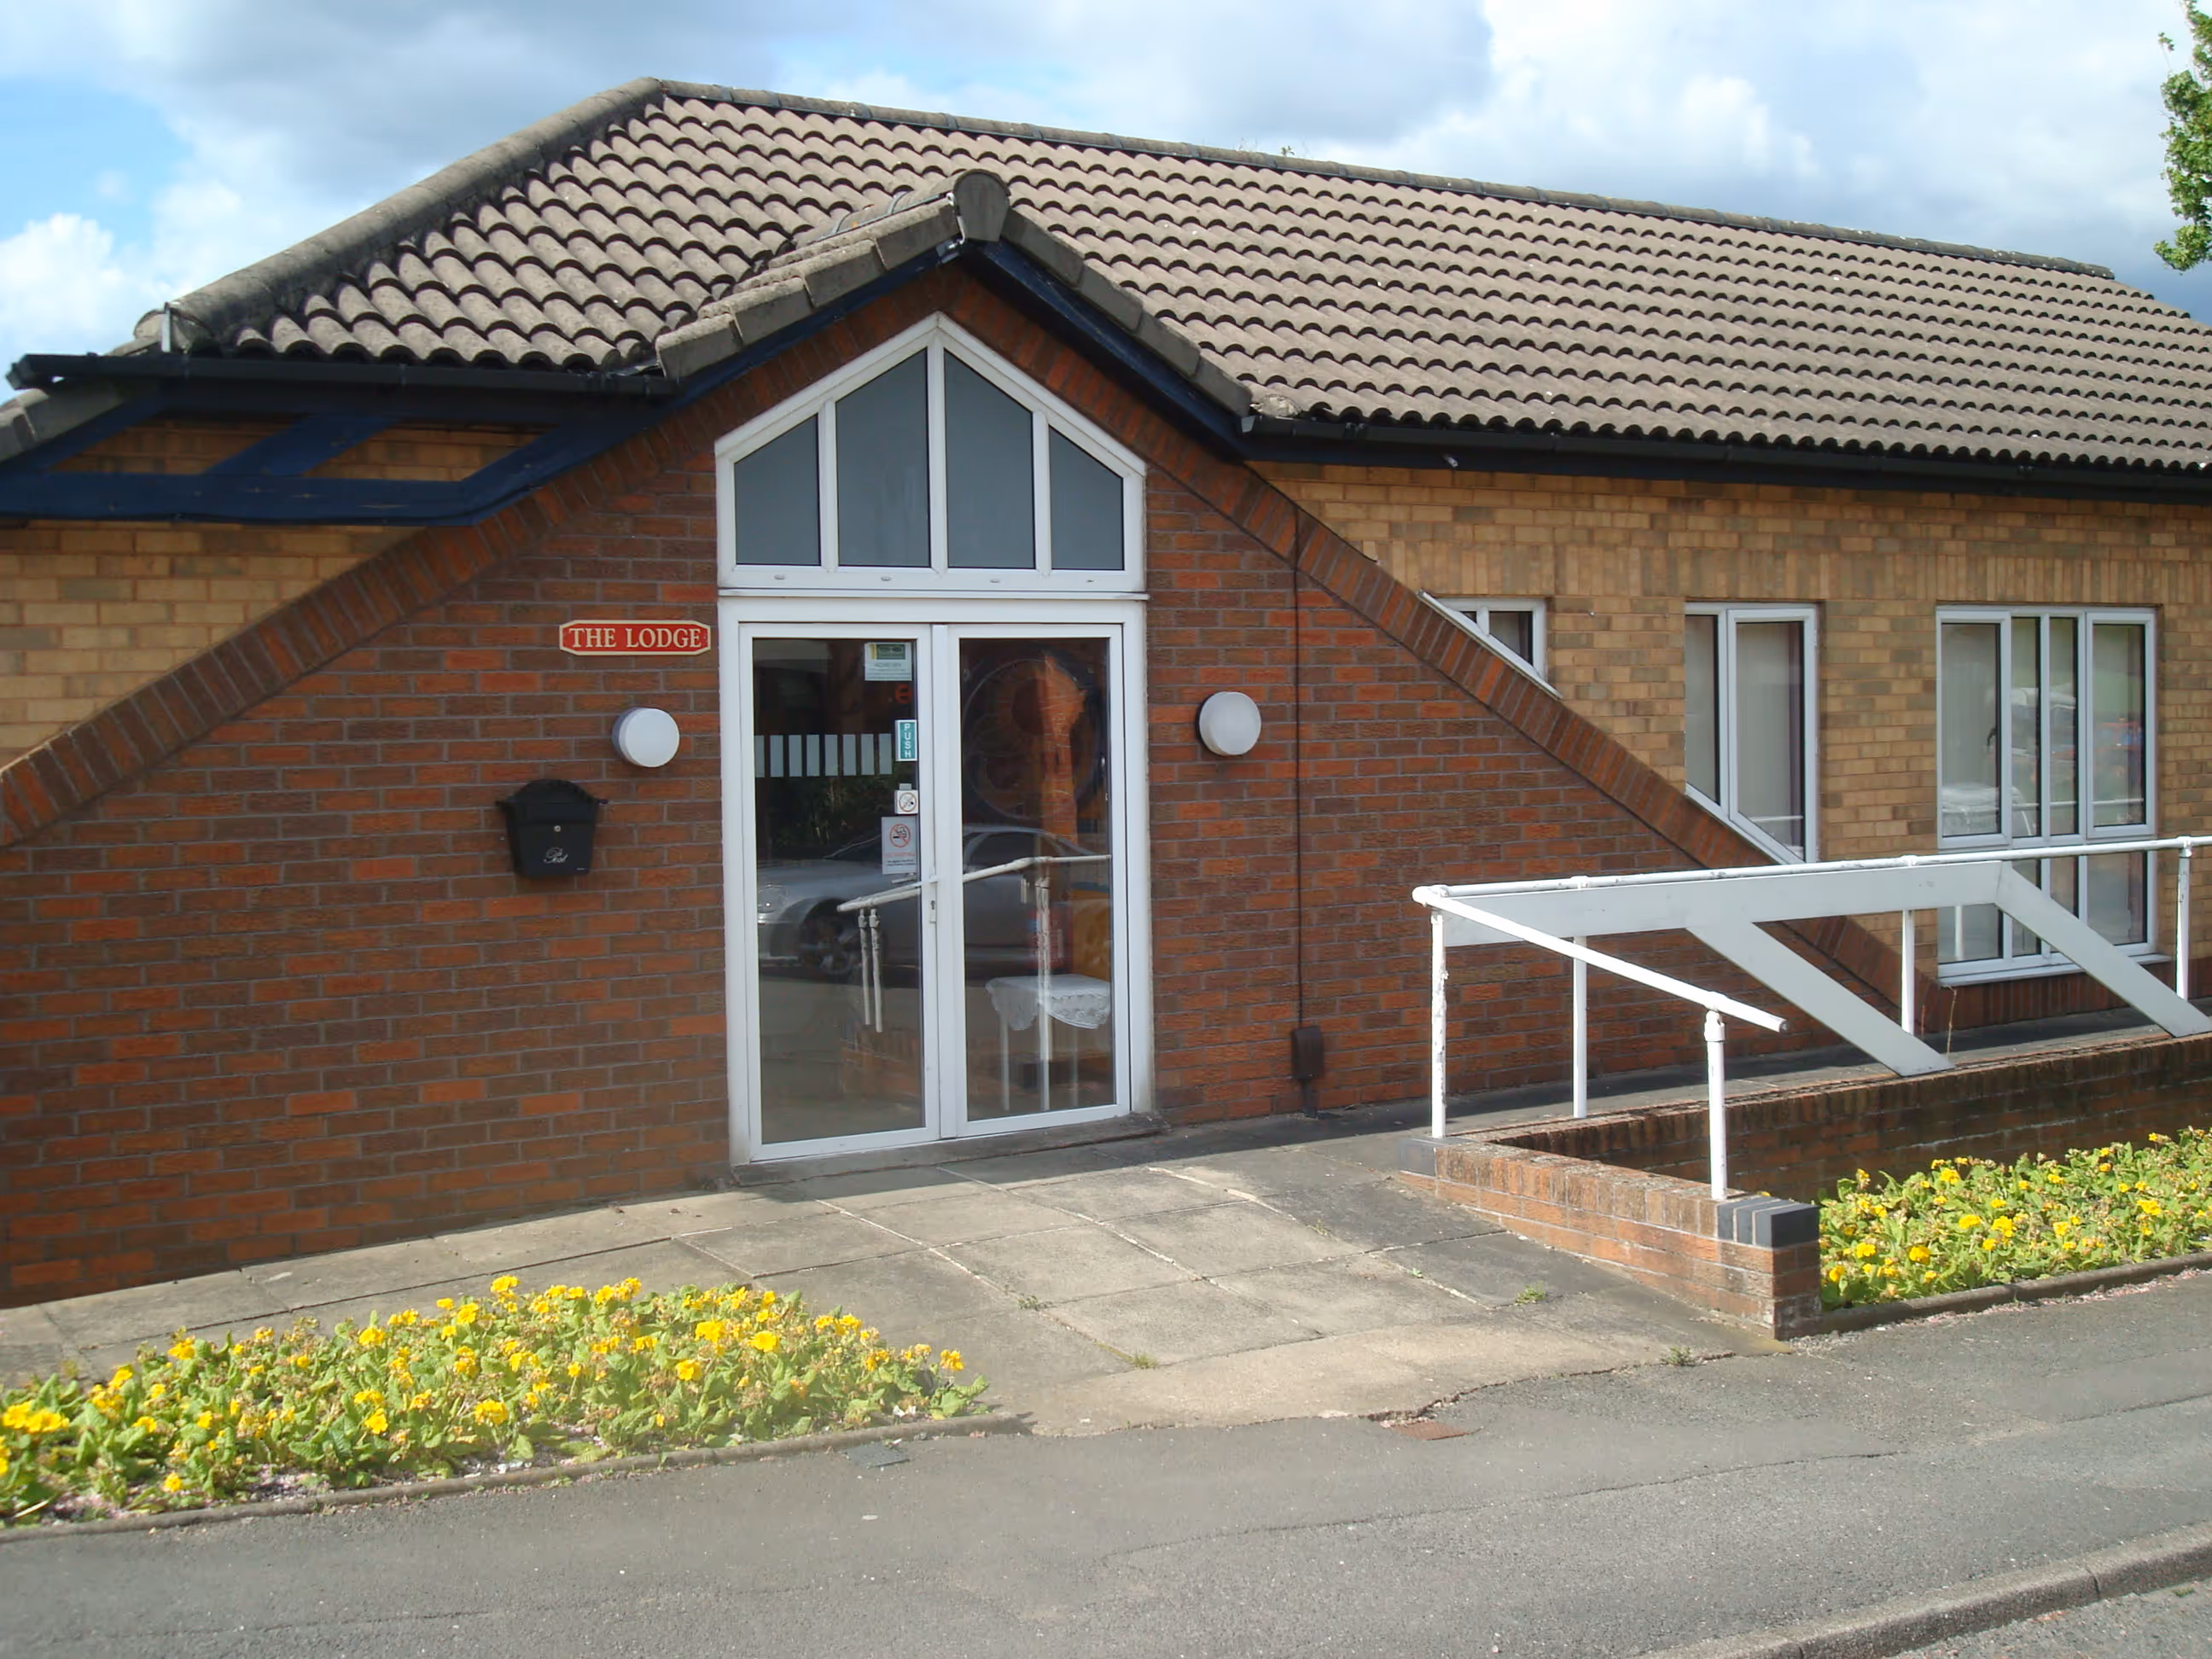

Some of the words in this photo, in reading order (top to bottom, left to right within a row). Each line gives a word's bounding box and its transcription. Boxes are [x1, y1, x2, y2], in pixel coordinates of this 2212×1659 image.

[568, 627, 617, 649] THE
[625, 627, 702, 649] LODGE
[903, 722, 912, 759] PUSH
